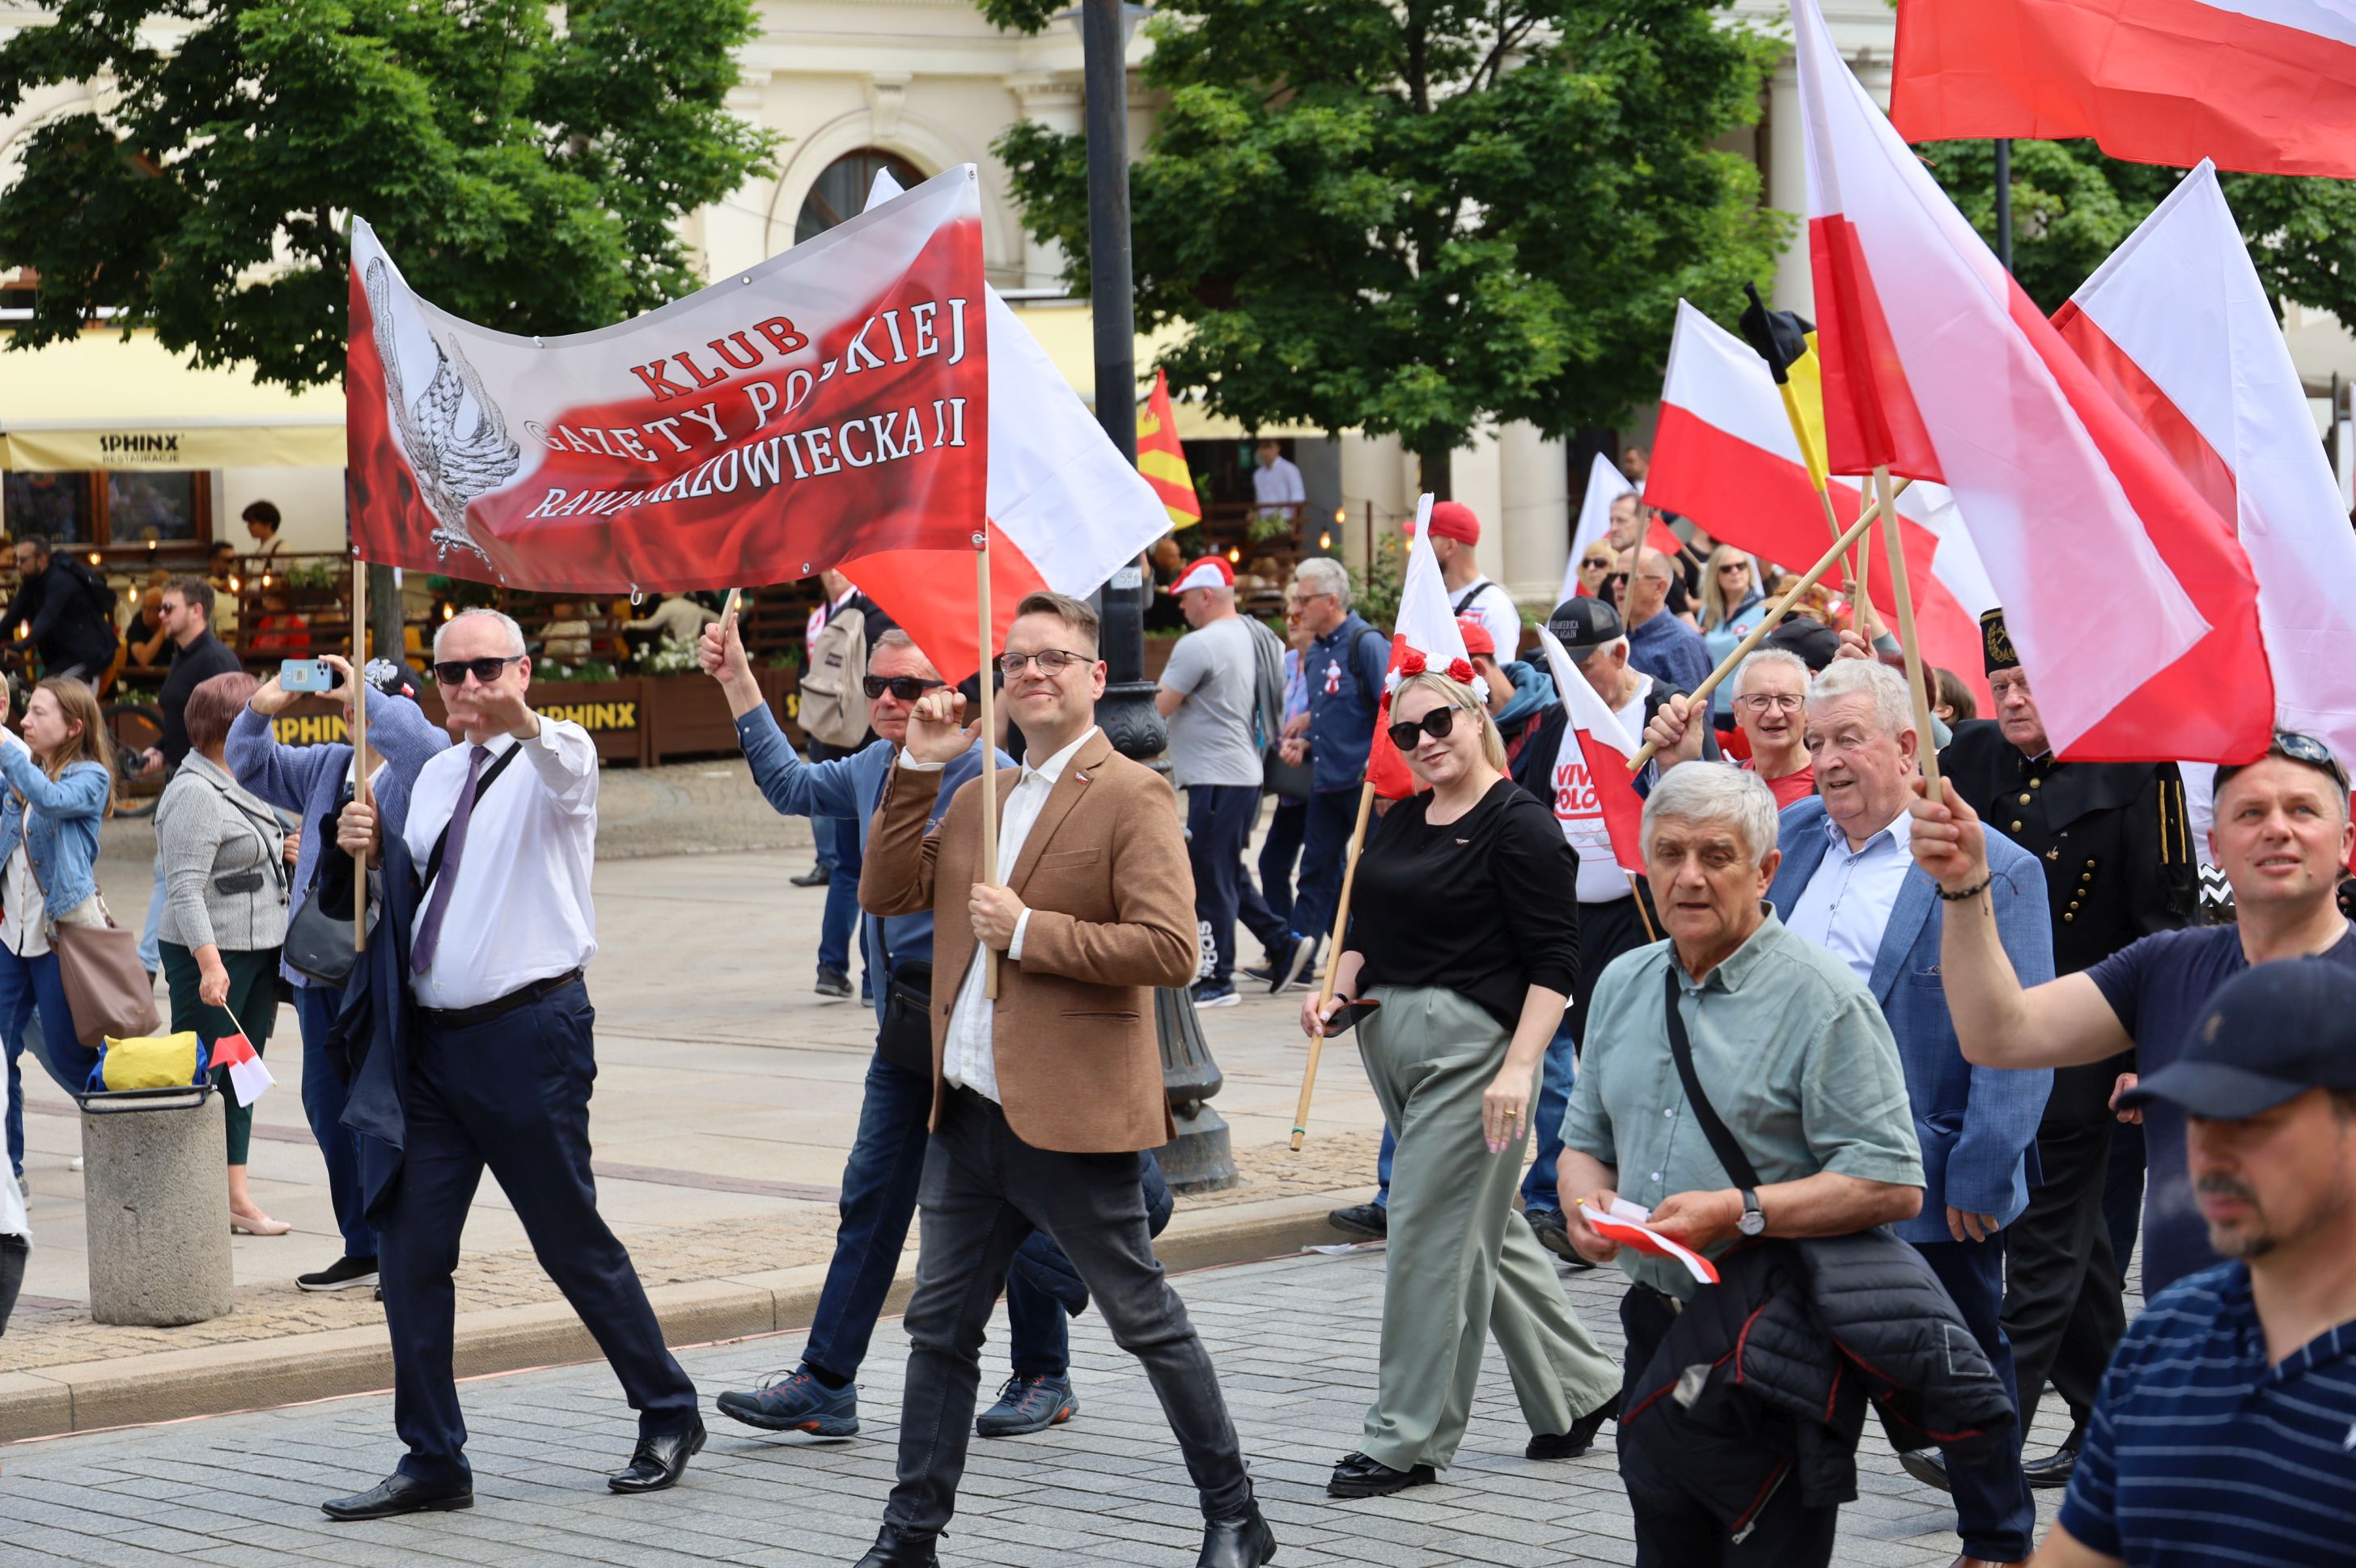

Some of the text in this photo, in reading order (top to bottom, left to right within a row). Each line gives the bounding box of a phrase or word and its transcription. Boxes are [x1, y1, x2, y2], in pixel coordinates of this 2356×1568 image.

[629, 316, 809, 402] KLUB
[523, 298, 968, 463] GAZETY POKIEJ
[932, 397, 968, 447] II
[100, 434, 179, 452] SPHINX
[271, 714, 348, 744] SPHIN
[1557, 764, 1594, 786] VIV
